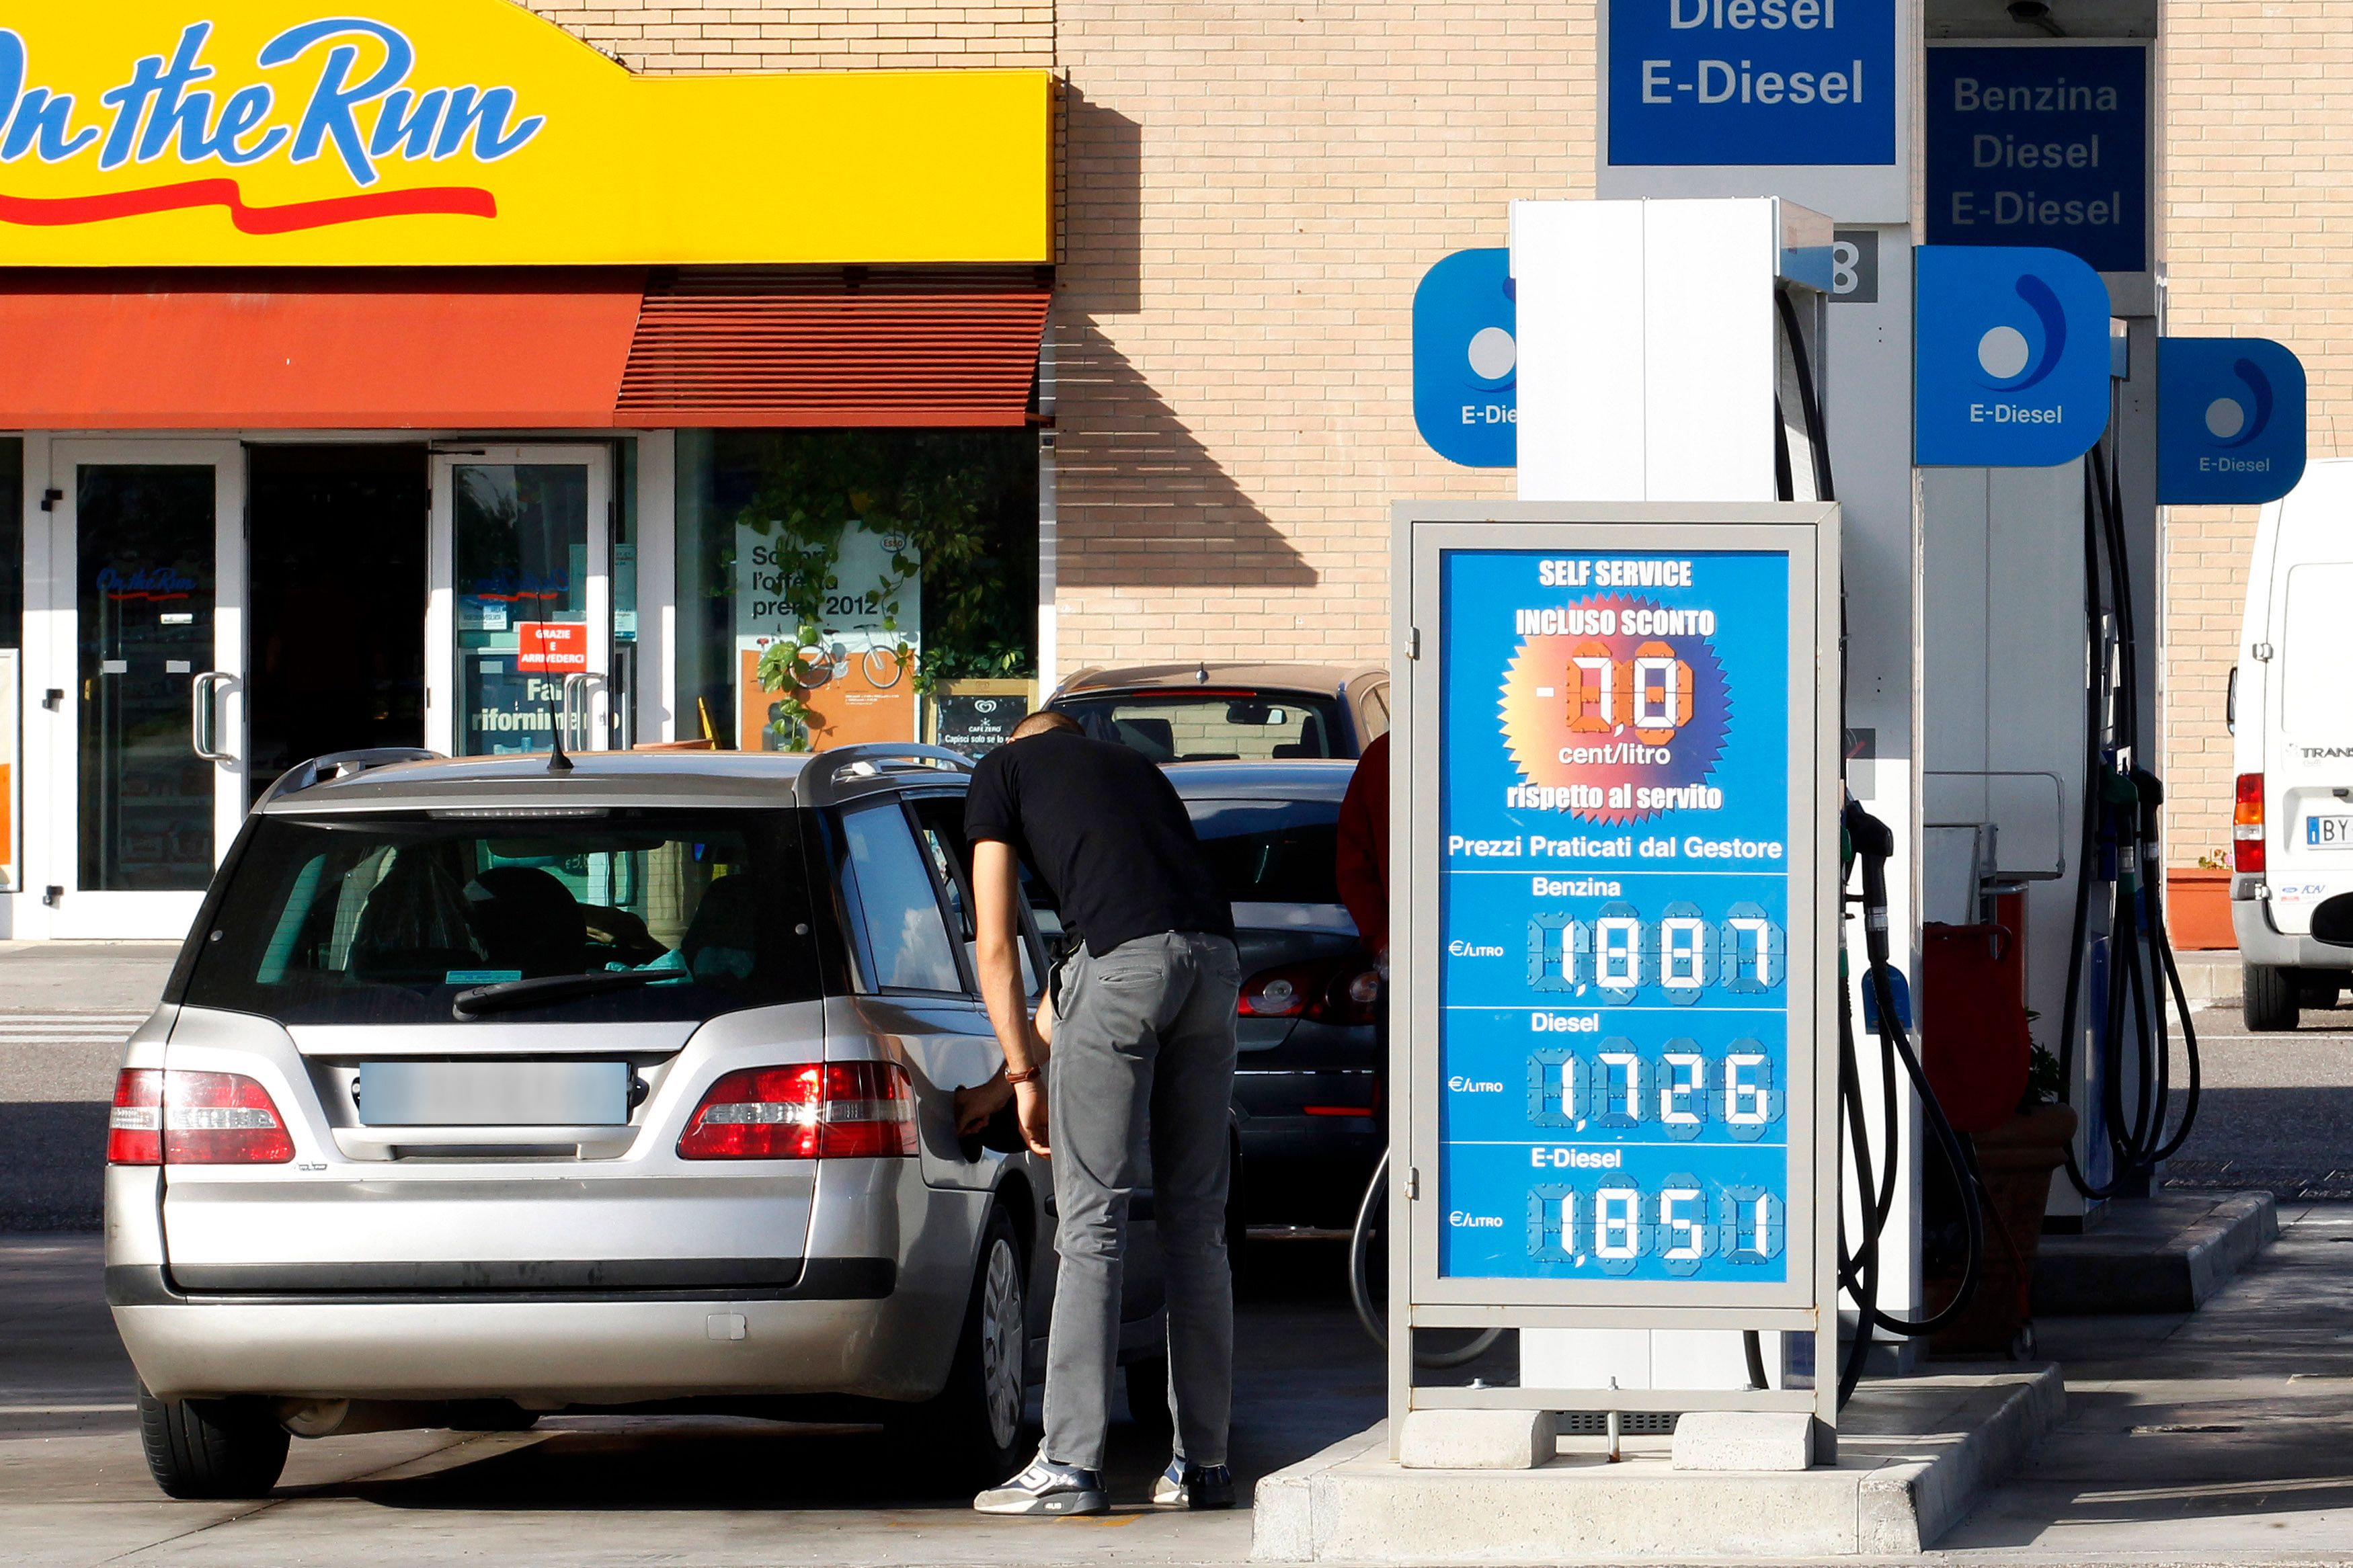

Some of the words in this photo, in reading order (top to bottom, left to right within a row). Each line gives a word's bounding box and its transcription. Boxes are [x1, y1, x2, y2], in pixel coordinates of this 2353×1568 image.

[1671, 0, 1835, 30] Diesel
[1642, 60, 1864, 105] E-Diesel
[1953, 77, 2118, 112] Benzina
[99, 19, 290, 171] the
[257, 16, 547, 188] Run
[1972, 134, 2100, 169] Diesel
[1951, 190, 2121, 226] E-Diesel
[1970, 403, 2063, 424] E-Diesel
[2198, 456, 2270, 472] E-Diesel
[1539, 560, 1592, 587] SELF
[1595, 561, 1693, 588] SERVICE
[826, 596, 878, 615] 2012
[535, 630, 571, 638] GRAZIE
[1515, 609, 1617, 636] INCLUSO
[1620, 610, 1716, 637] SCONTO
[521, 653, 584, 663] ARRIVEDERCI
[550, 642, 556, 651] E
[526, 677, 563, 701] Fai
[945, 735, 969, 745] Capisci
[971, 735, 986, 743] solo
[997, 735, 1004, 743] lo
[1557, 742, 1672, 766] cent/litro
[1507, 782, 1604, 811] rispetto
[1608, 783, 1632, 810] al
[1636, 783, 1723, 811] servito
[1448, 835, 1522, 858] Prezzi
[1530, 835, 1632, 858] Praticati
[1638, 836, 1677, 858] dal
[1683, 836, 1784, 860] Gestore
[1532, 876, 1622, 897] Benzina
[1448, 940, 1505, 957] €/LITRO
[1561, 916, 1769, 998] 1,887
[1531, 1013, 1599, 1034] Diesel
[1447, 1076, 1505, 1094] €/LITRO
[1561, 1053, 1769, 1132] 1,726
[1531, 1148, 1622, 1169] E-Diesel
[1449, 1210, 1505, 1228] €/LITRO
[1561, 1188, 1768, 1268] 1,851
